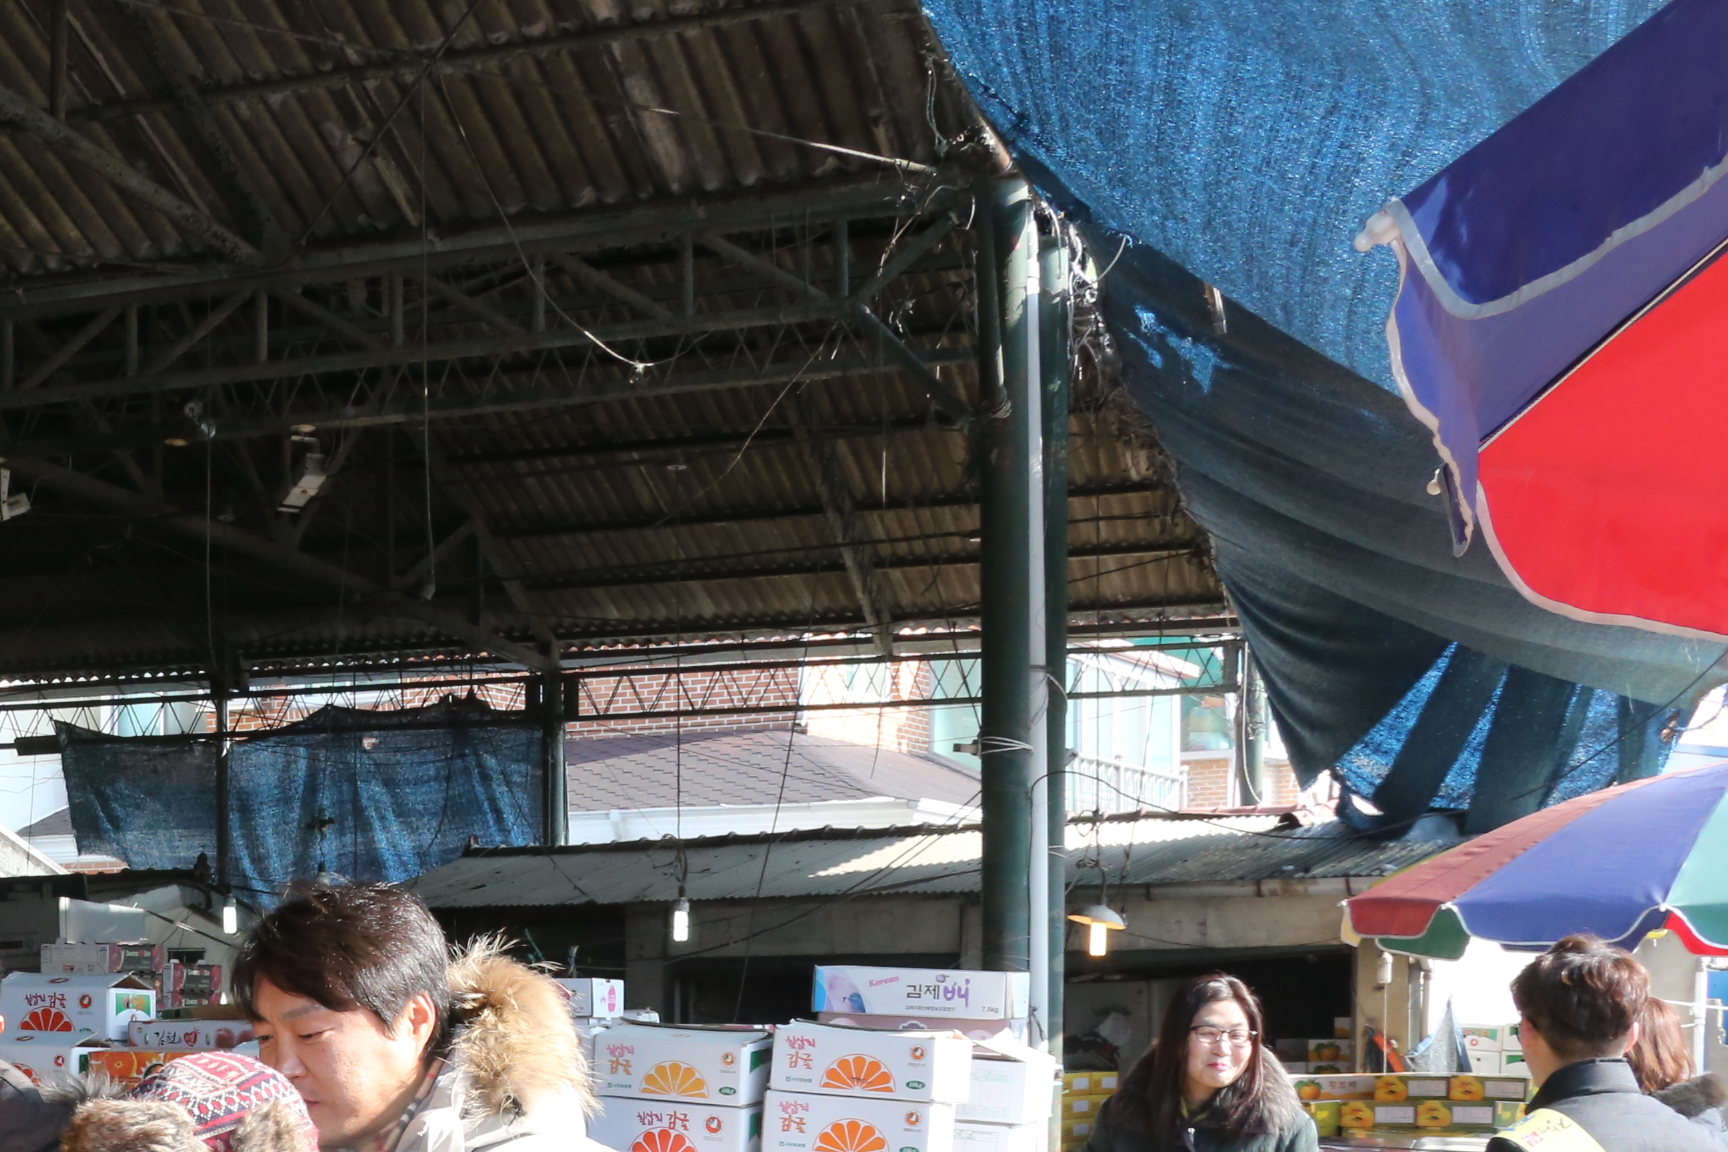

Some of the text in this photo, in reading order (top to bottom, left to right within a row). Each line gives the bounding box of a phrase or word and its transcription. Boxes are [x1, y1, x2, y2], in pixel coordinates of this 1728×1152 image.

[868, 975, 900, 988] Korean
[906, 983, 941, 1000] 김제
[787, 1051, 813, 1070] 감귤
[780, 1115, 807, 1134] 감귤
